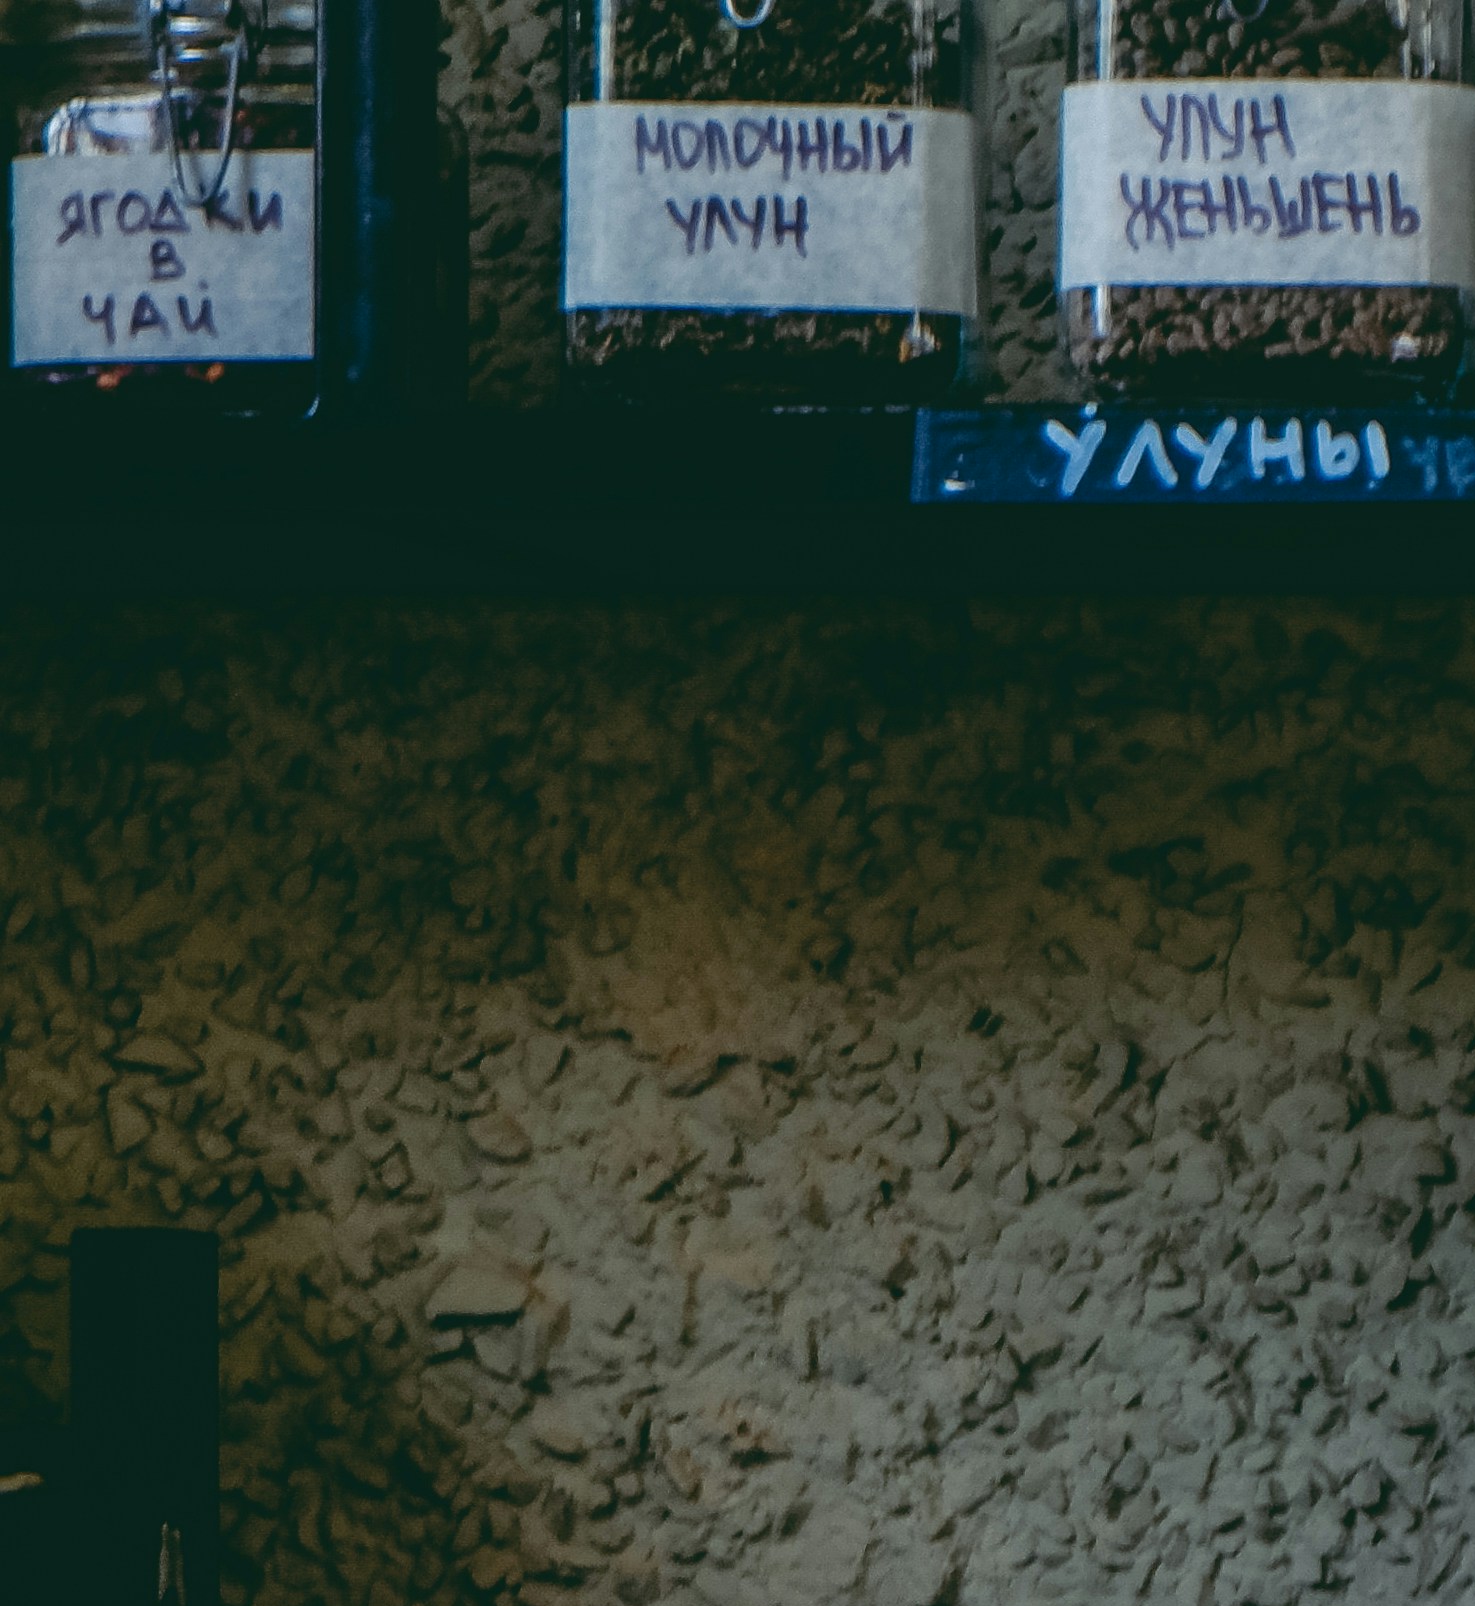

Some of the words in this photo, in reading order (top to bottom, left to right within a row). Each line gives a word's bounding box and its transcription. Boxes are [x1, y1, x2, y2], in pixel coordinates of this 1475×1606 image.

[634, 110, 914, 182] МОЛОЧНЫЙ
[1140, 92, 1297, 165] УЛУН
[56, 186, 284, 247] ЯГОДКИ
[664, 192, 811, 258] УЛУН
[1118, 169, 1423, 253] ЖЕНЬШЕНЬ
[82, 279, 220, 346] ЧАЙ
[1042, 415, 1393, 497] УЛУНЫ
